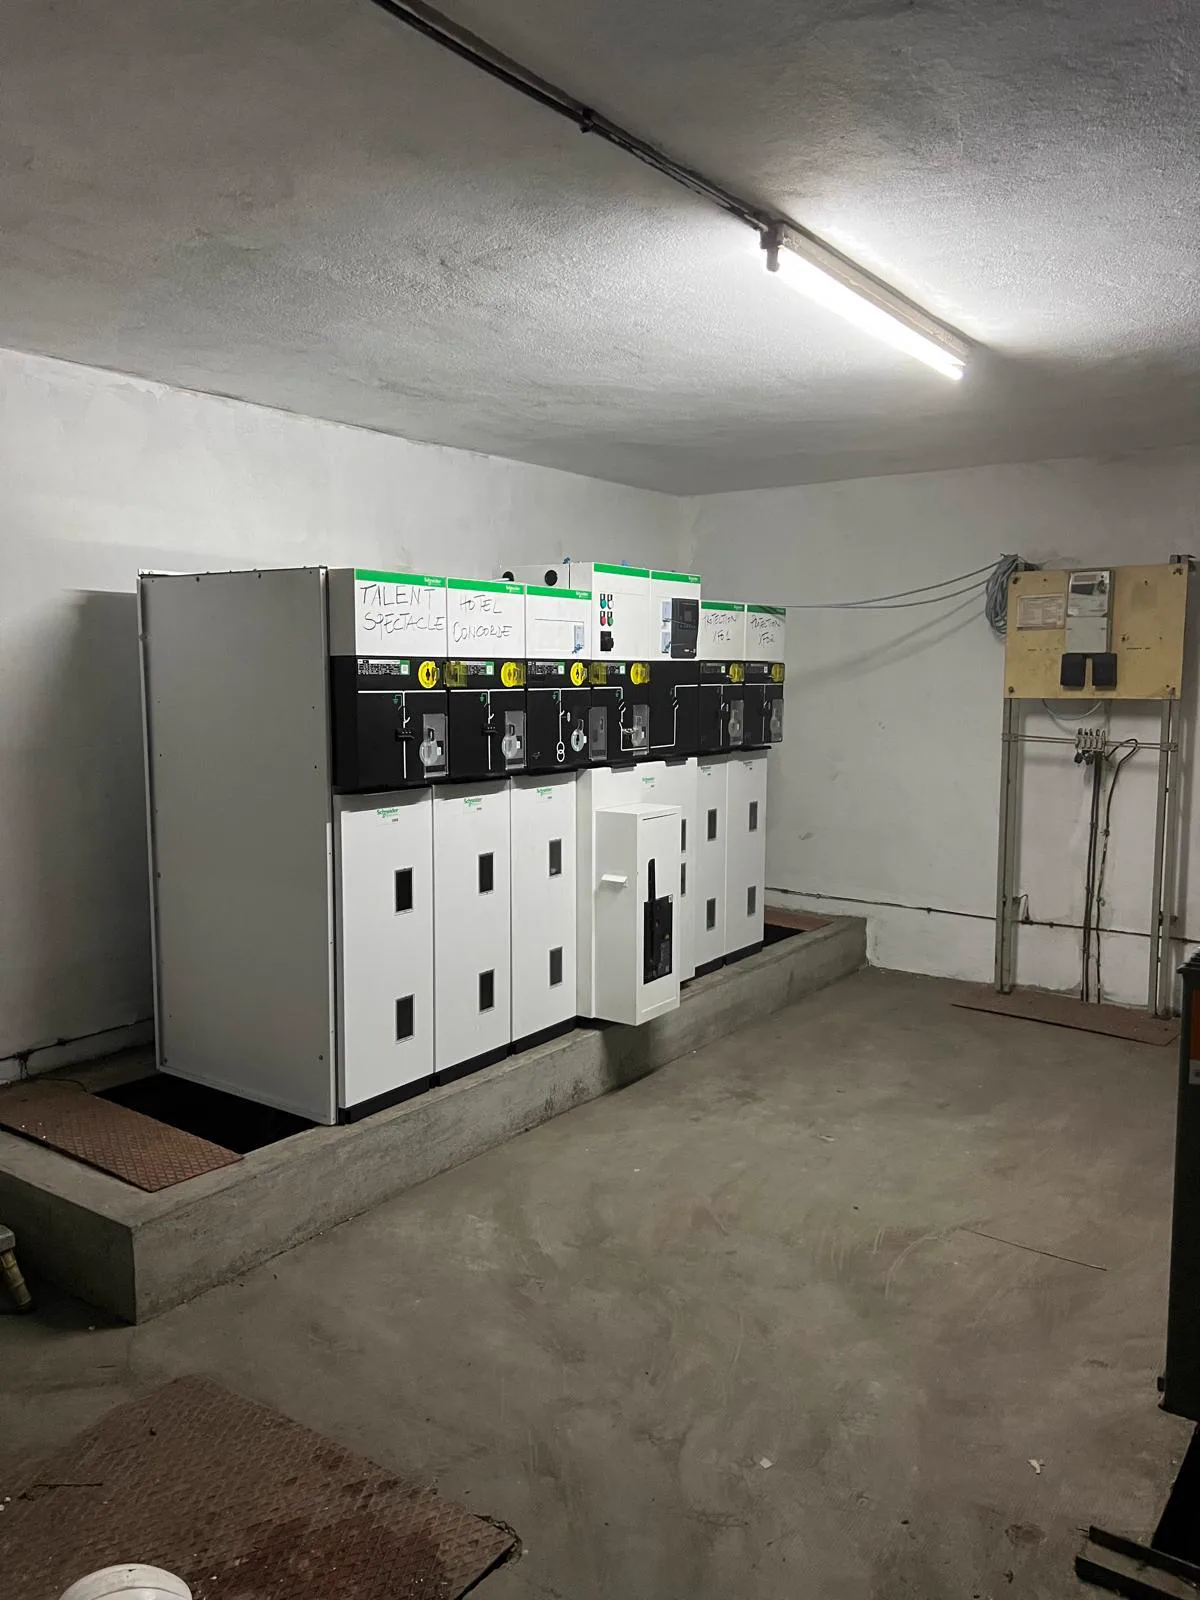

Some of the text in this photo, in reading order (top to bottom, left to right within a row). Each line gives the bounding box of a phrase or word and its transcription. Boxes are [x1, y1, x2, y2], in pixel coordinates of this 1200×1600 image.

[360, 584, 436, 609] TALENT
[460, 594, 502, 614] HOTEL
[363, 612, 445, 640] SPECTACLE
[452, 622, 512, 643] CONCORDE
